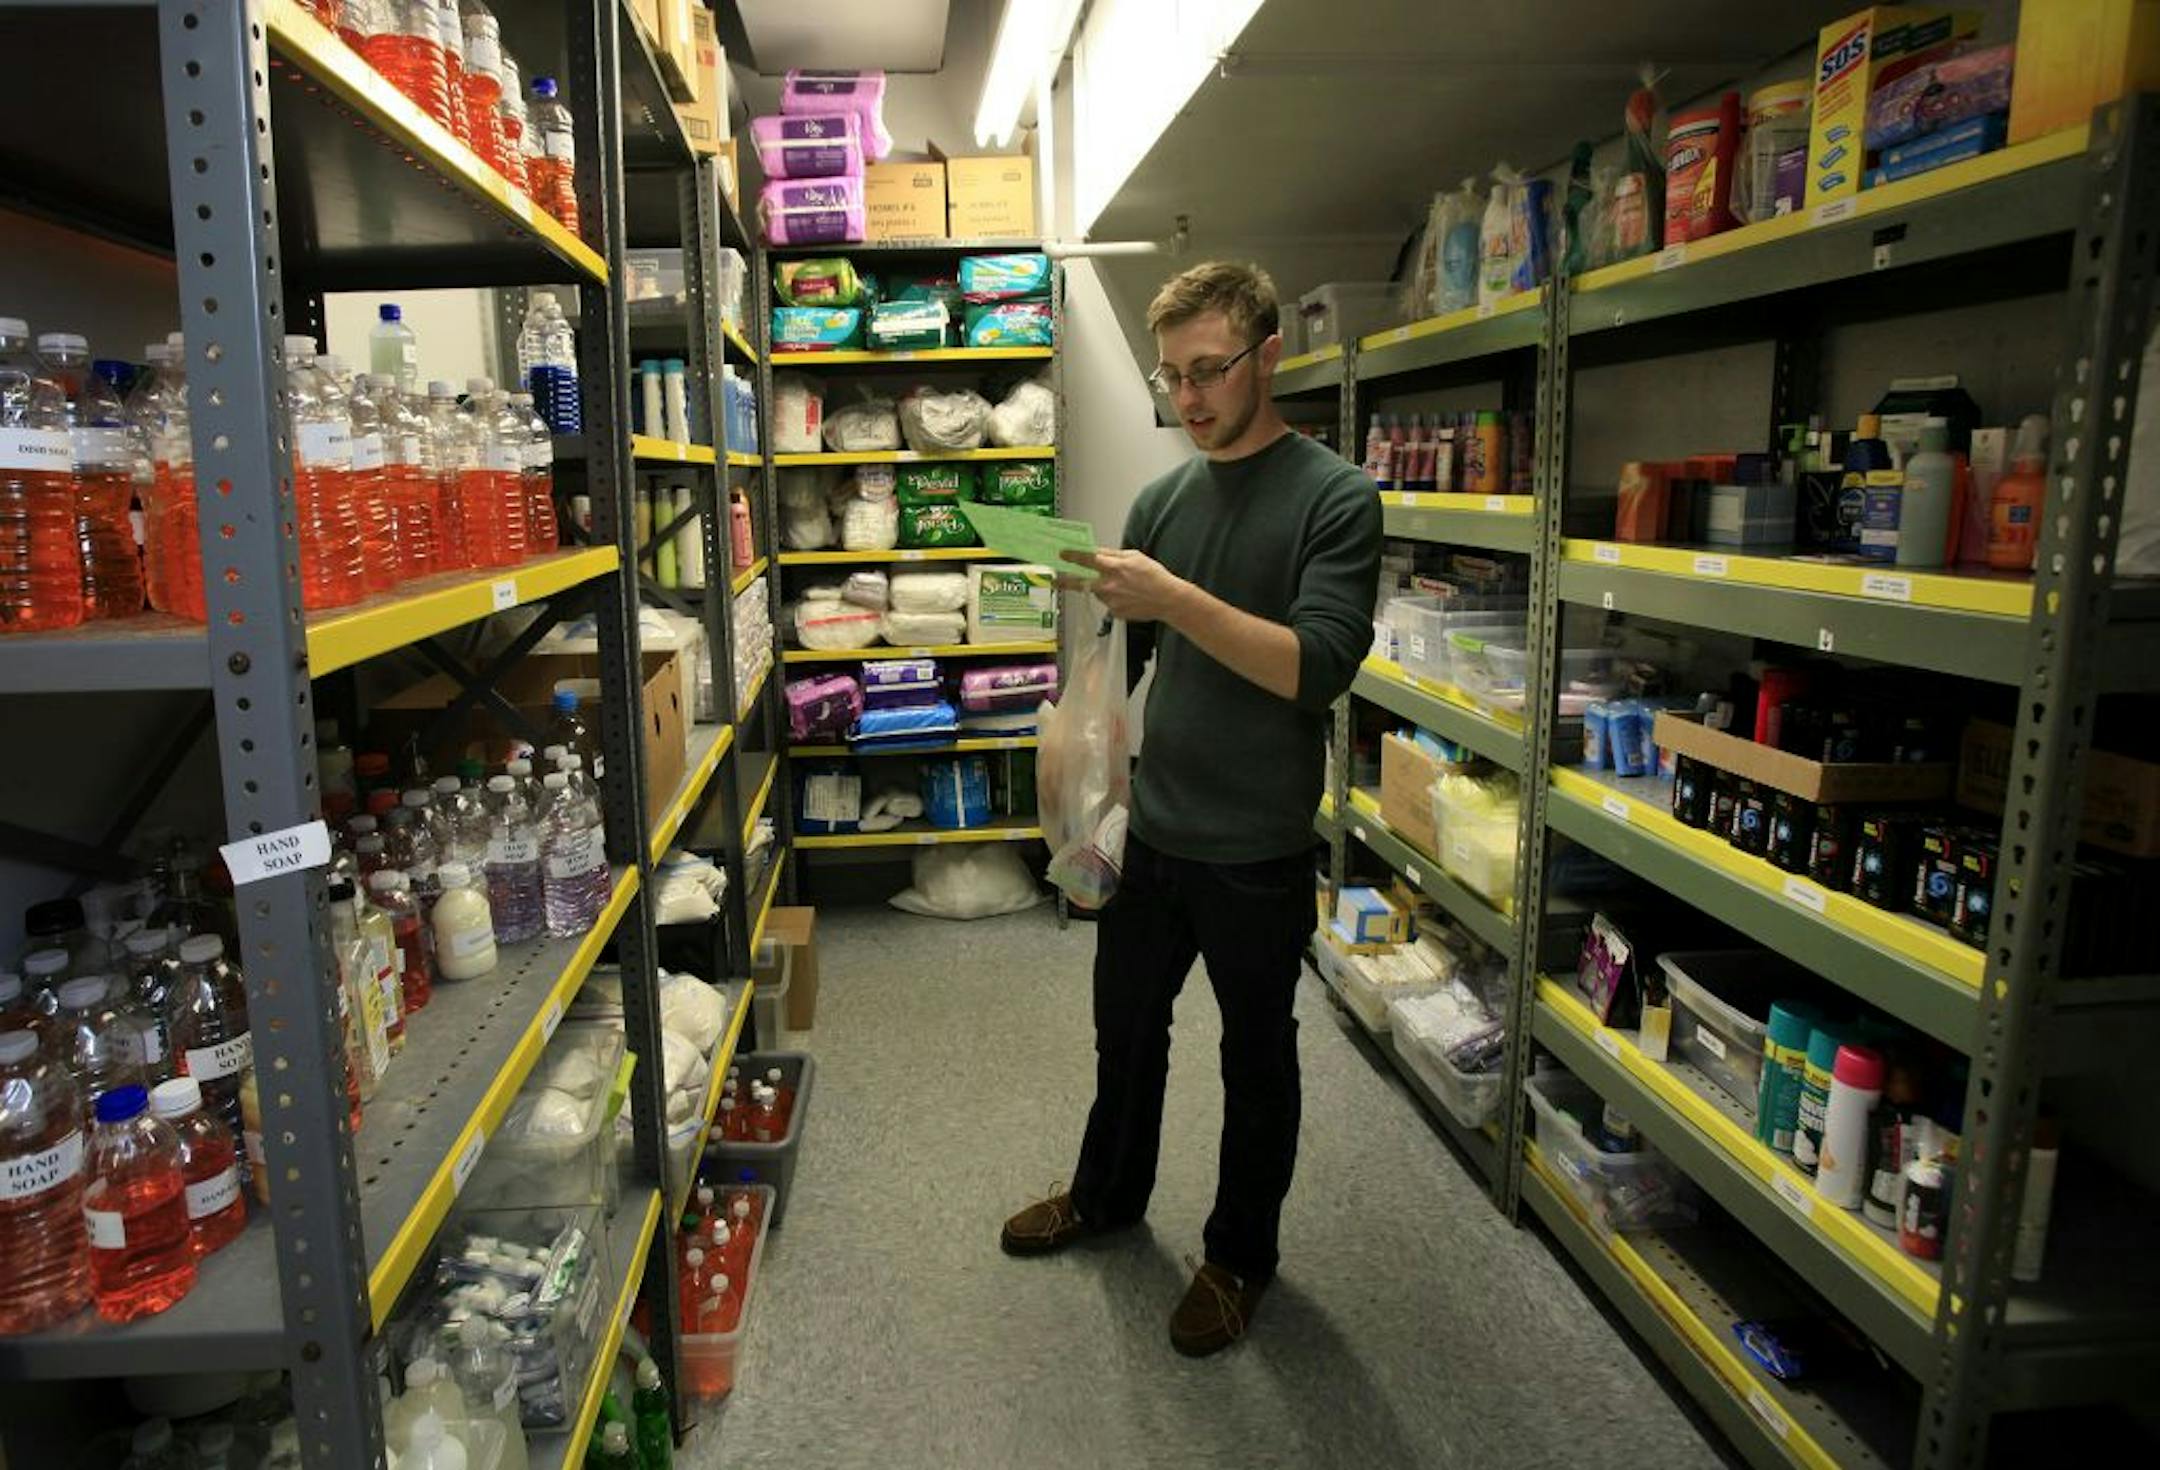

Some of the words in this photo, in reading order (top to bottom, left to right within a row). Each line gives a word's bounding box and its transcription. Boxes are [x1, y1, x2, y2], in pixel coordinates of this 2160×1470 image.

[257, 835, 301, 855] HAND
[263, 851, 303, 872] SOAP
[8, 1152, 60, 1178] HAND
[12, 1169, 59, 1194] SOAP
